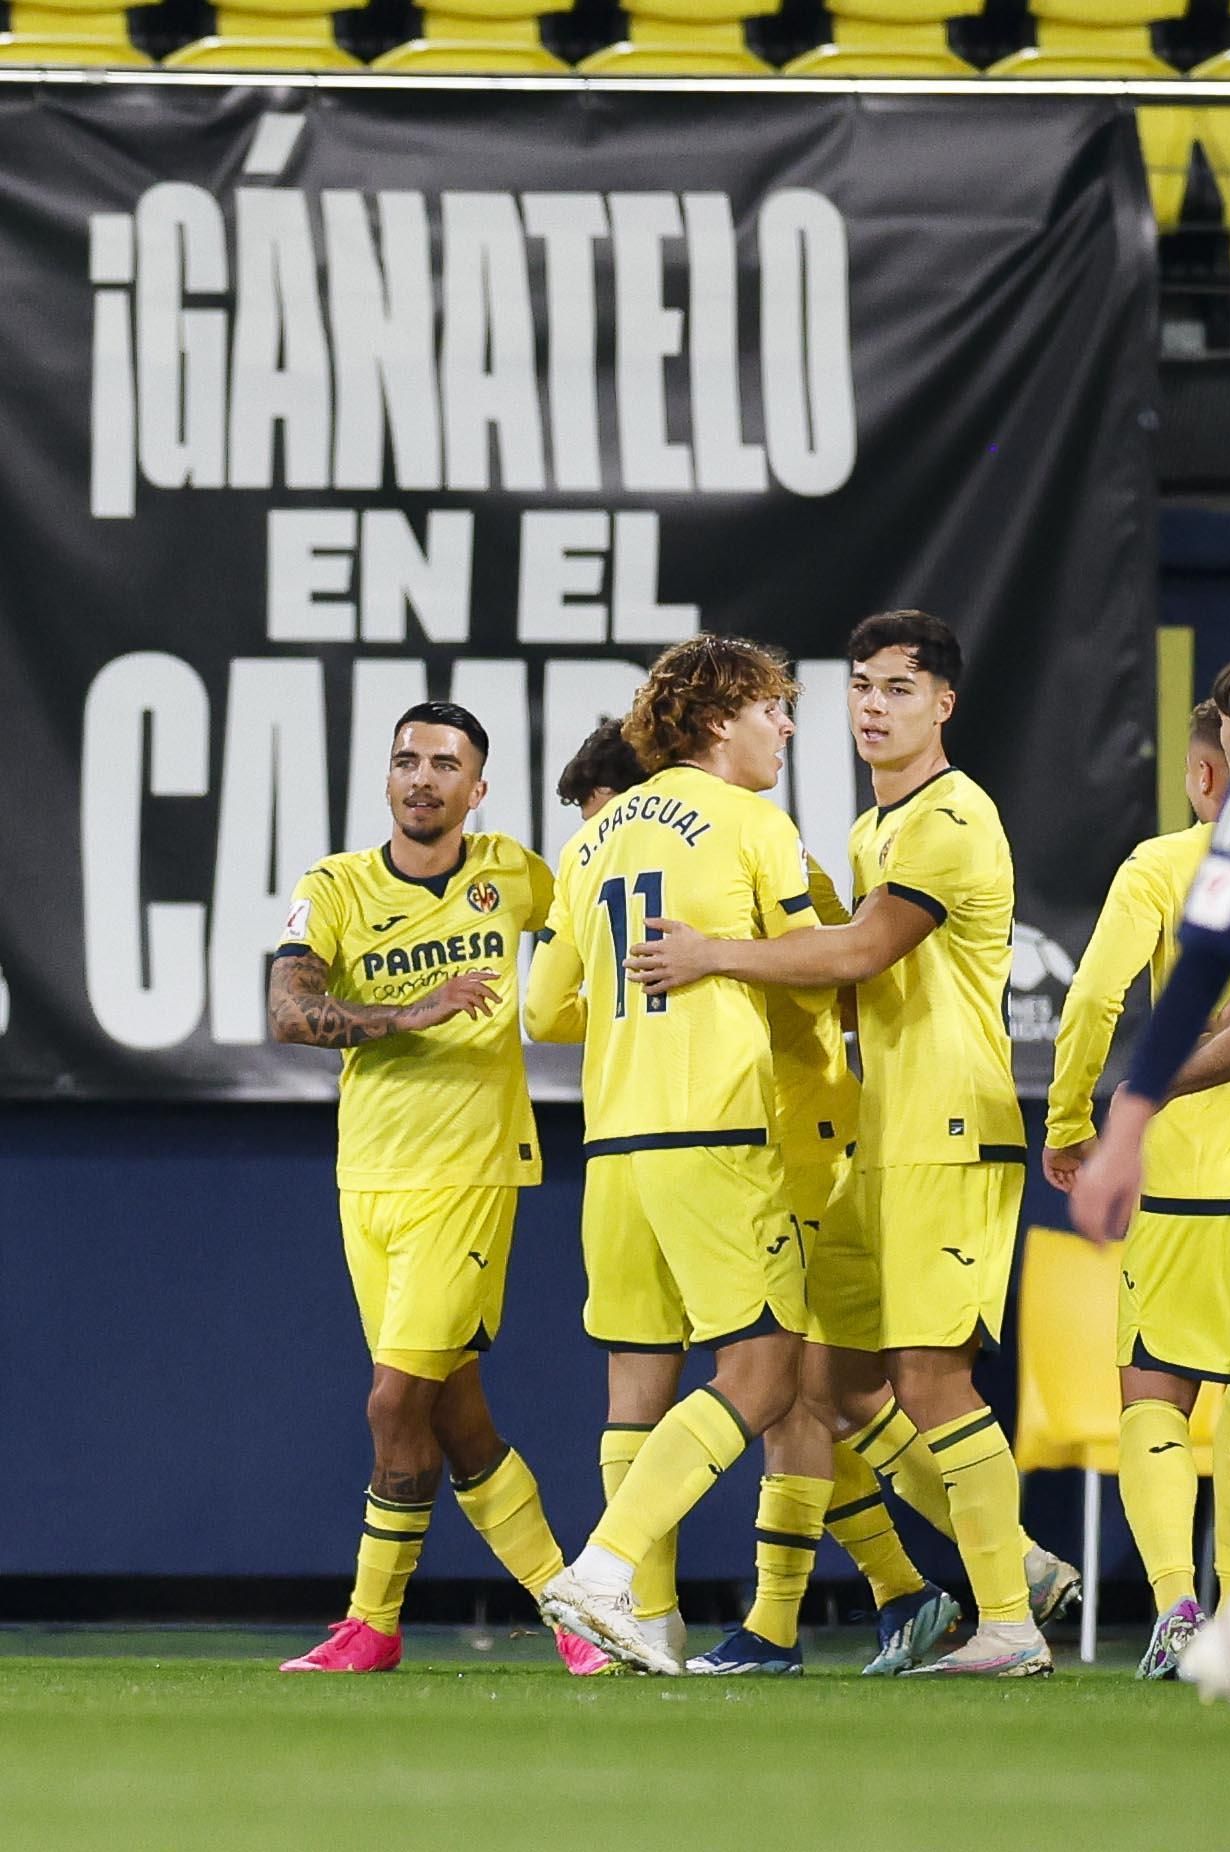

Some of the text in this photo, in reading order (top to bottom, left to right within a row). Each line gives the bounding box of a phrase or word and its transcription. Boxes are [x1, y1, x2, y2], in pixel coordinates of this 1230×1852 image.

[88, 111, 858, 519] ¡GÁNATELO
[266, 508, 701, 645] EN EL
[362, 930, 504, 981] PAMESA
[597, 870, 668, 1018] 11
